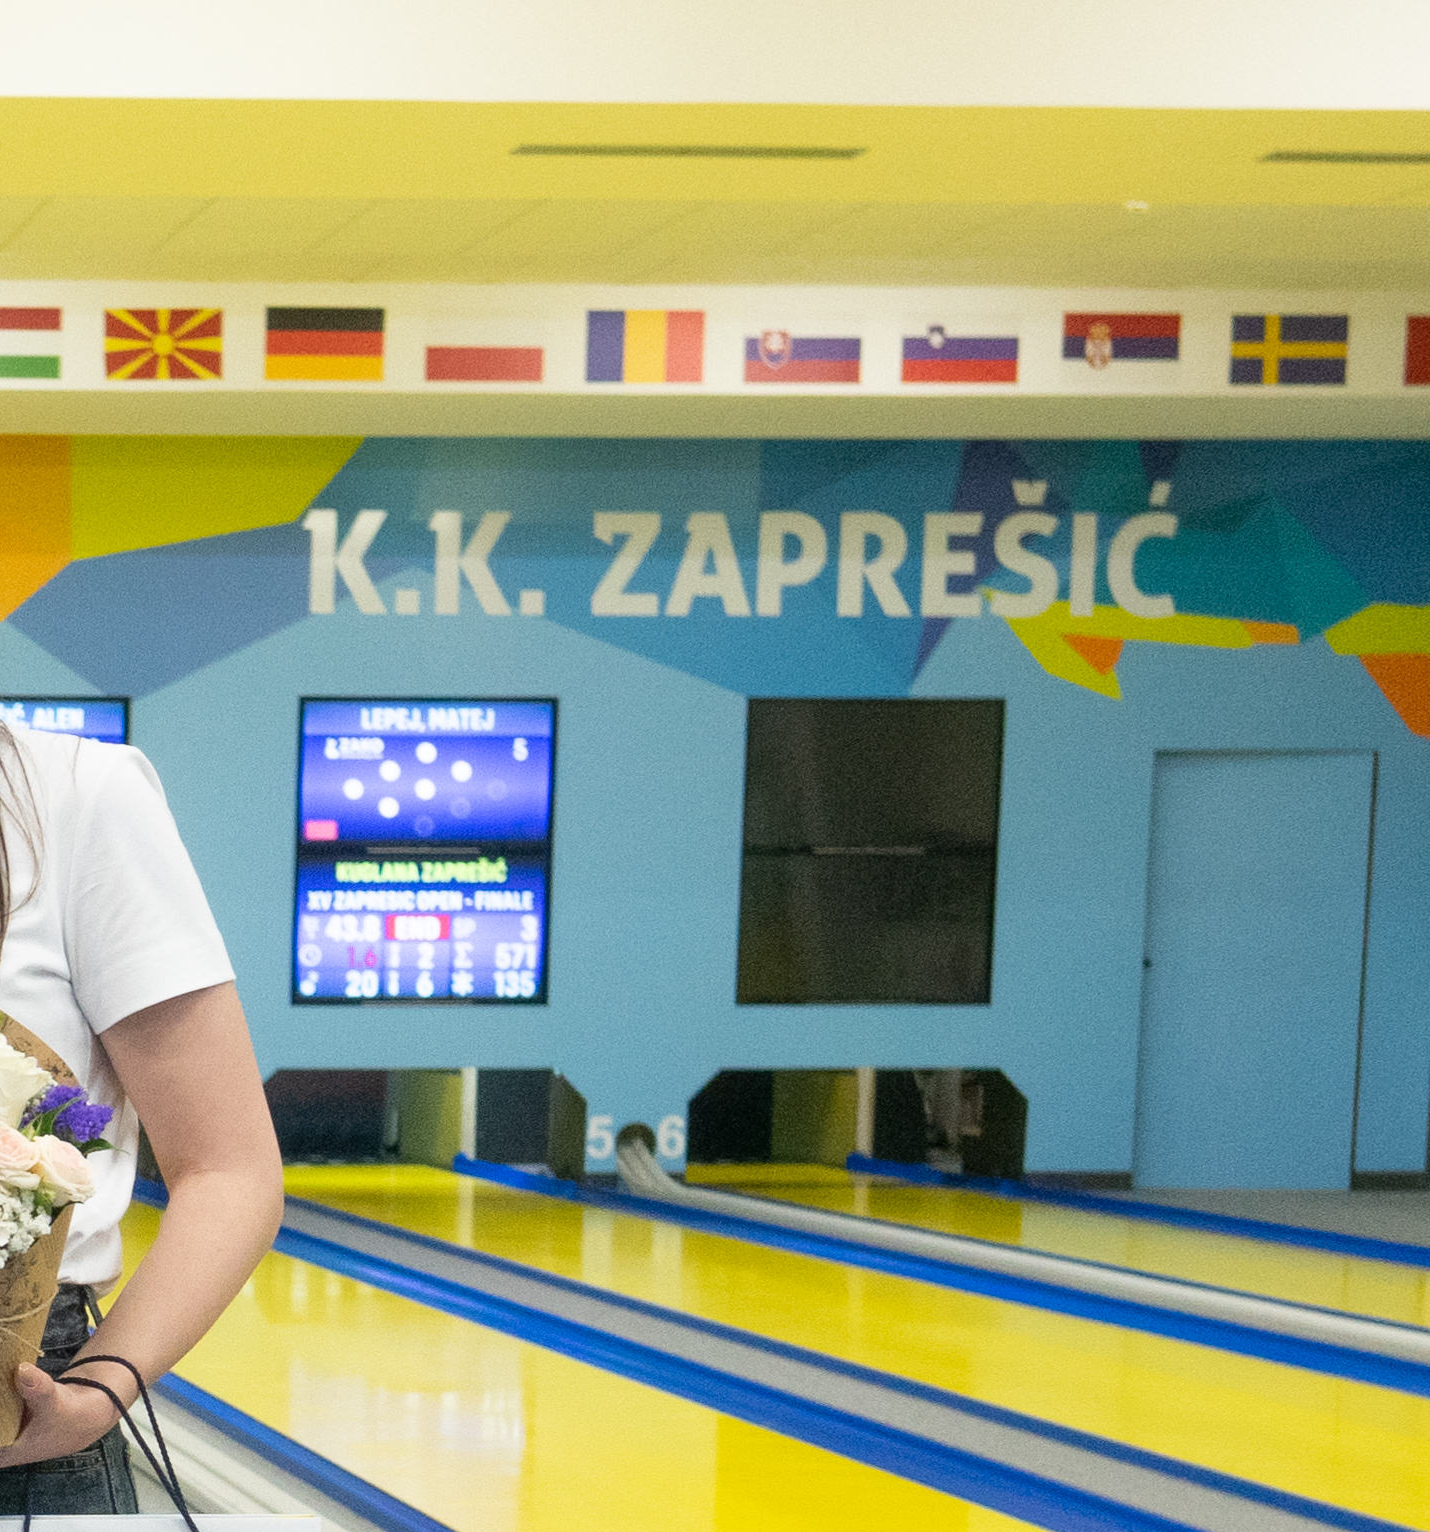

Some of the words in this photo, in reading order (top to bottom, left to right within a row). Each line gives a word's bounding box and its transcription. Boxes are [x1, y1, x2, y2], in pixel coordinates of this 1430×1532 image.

[302, 508, 545, 617] K.K.
[591, 480, 1179, 618] ZAPREŠIĆ
[587, 1115, 613, 1158] 5
[657, 1115, 685, 1158] 6
